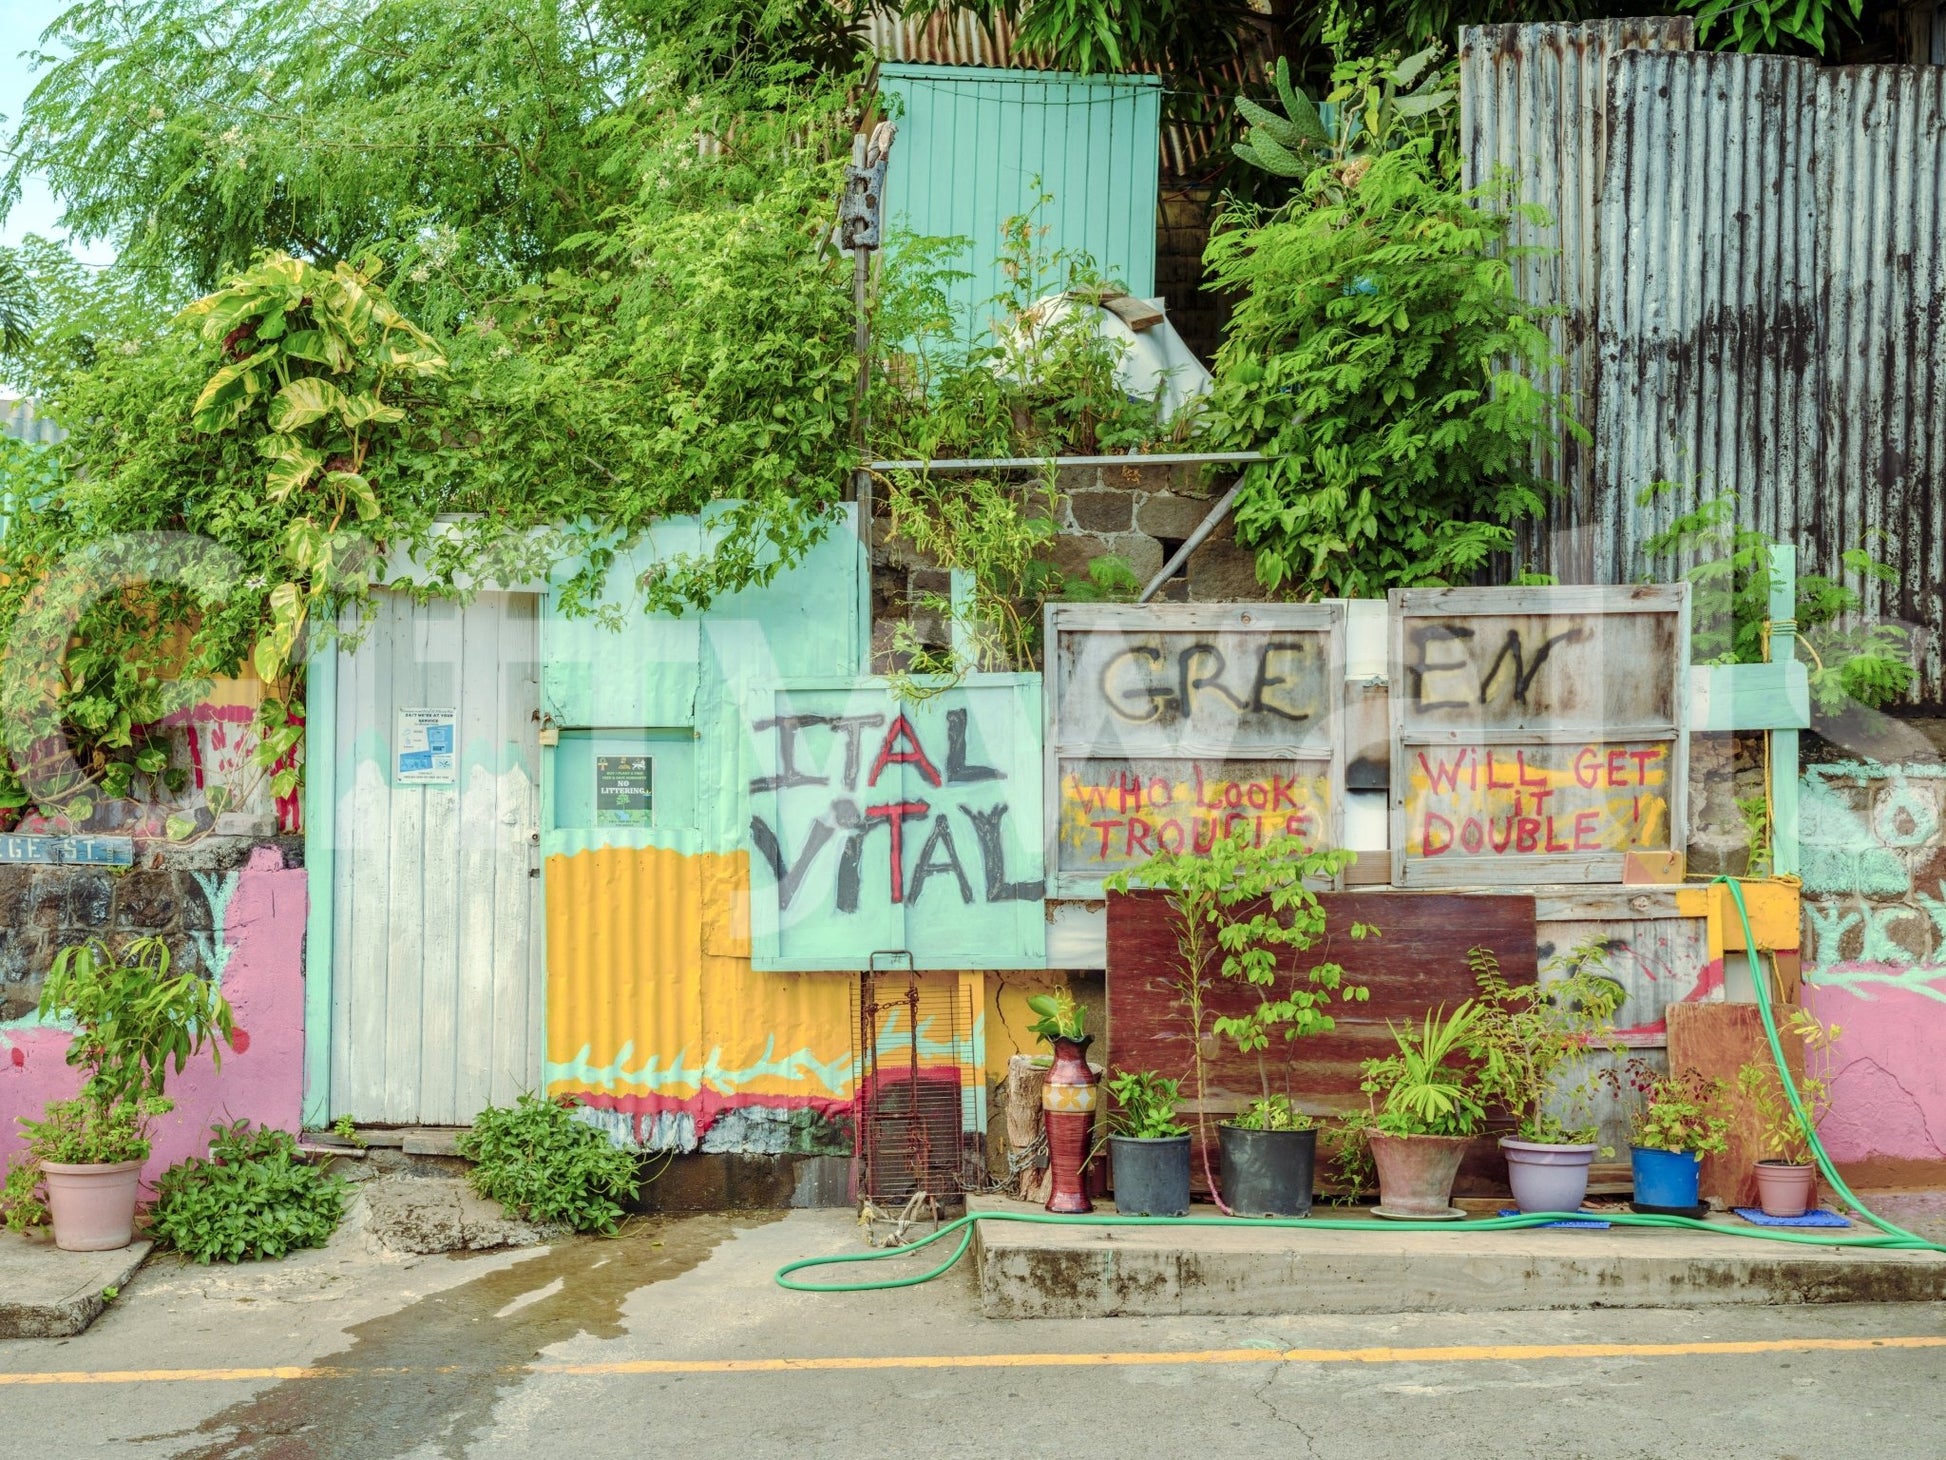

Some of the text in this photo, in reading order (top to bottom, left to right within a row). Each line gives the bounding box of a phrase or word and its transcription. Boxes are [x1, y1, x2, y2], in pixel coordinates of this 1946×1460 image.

[1573, 745, 1663, 790] GET
[1071, 770, 1172, 816] WHO
[1422, 810, 1604, 858] DOUBLE
